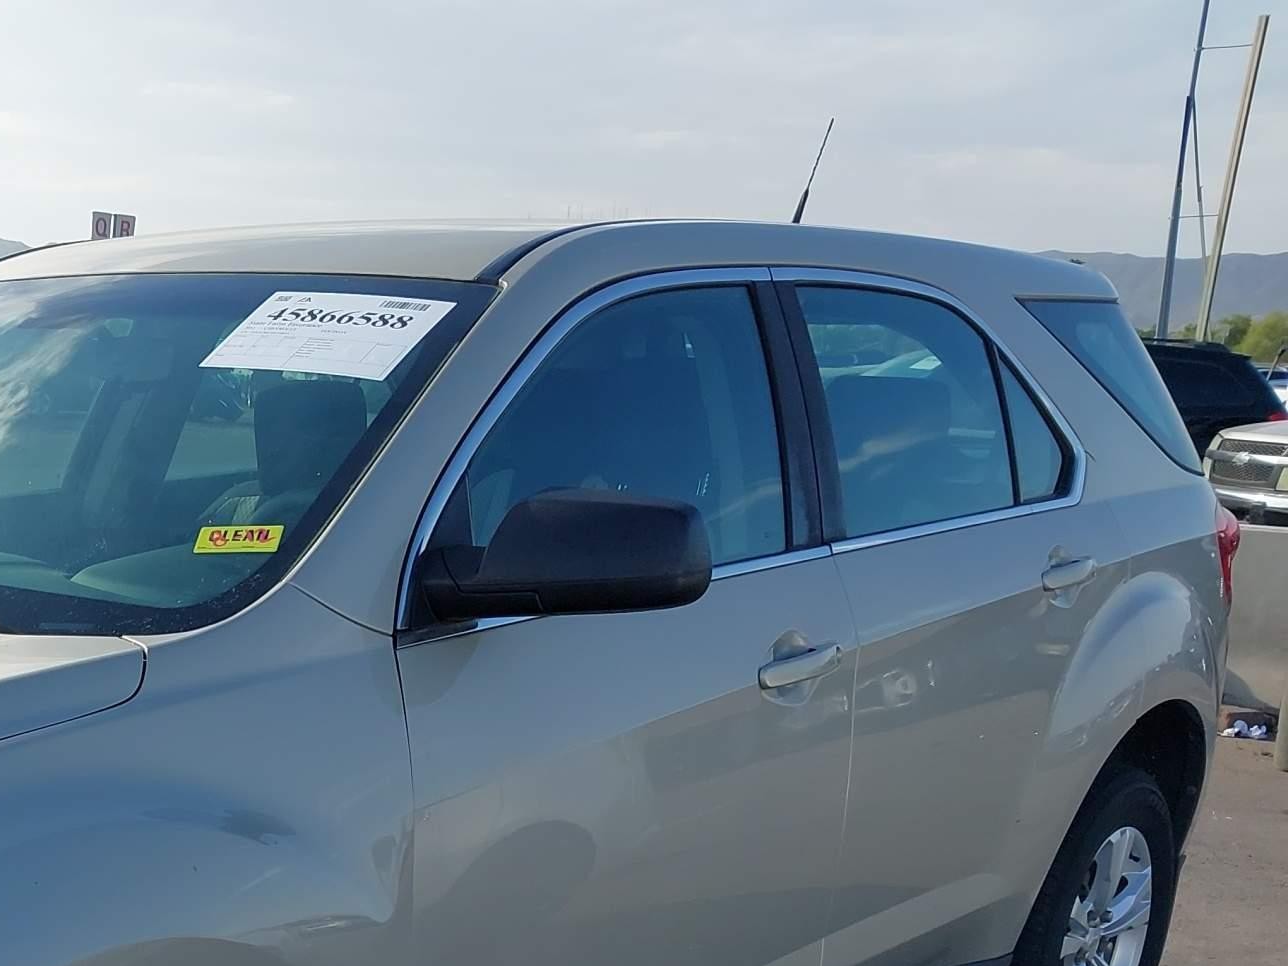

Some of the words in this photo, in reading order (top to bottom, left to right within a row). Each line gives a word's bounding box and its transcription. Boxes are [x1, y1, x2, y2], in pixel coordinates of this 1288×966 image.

[95, 217, 108, 238] Q
[120, 220, 131, 237] R
[267, 307, 414, 330] 45866588
[209, 529, 271, 542] CLEAN
